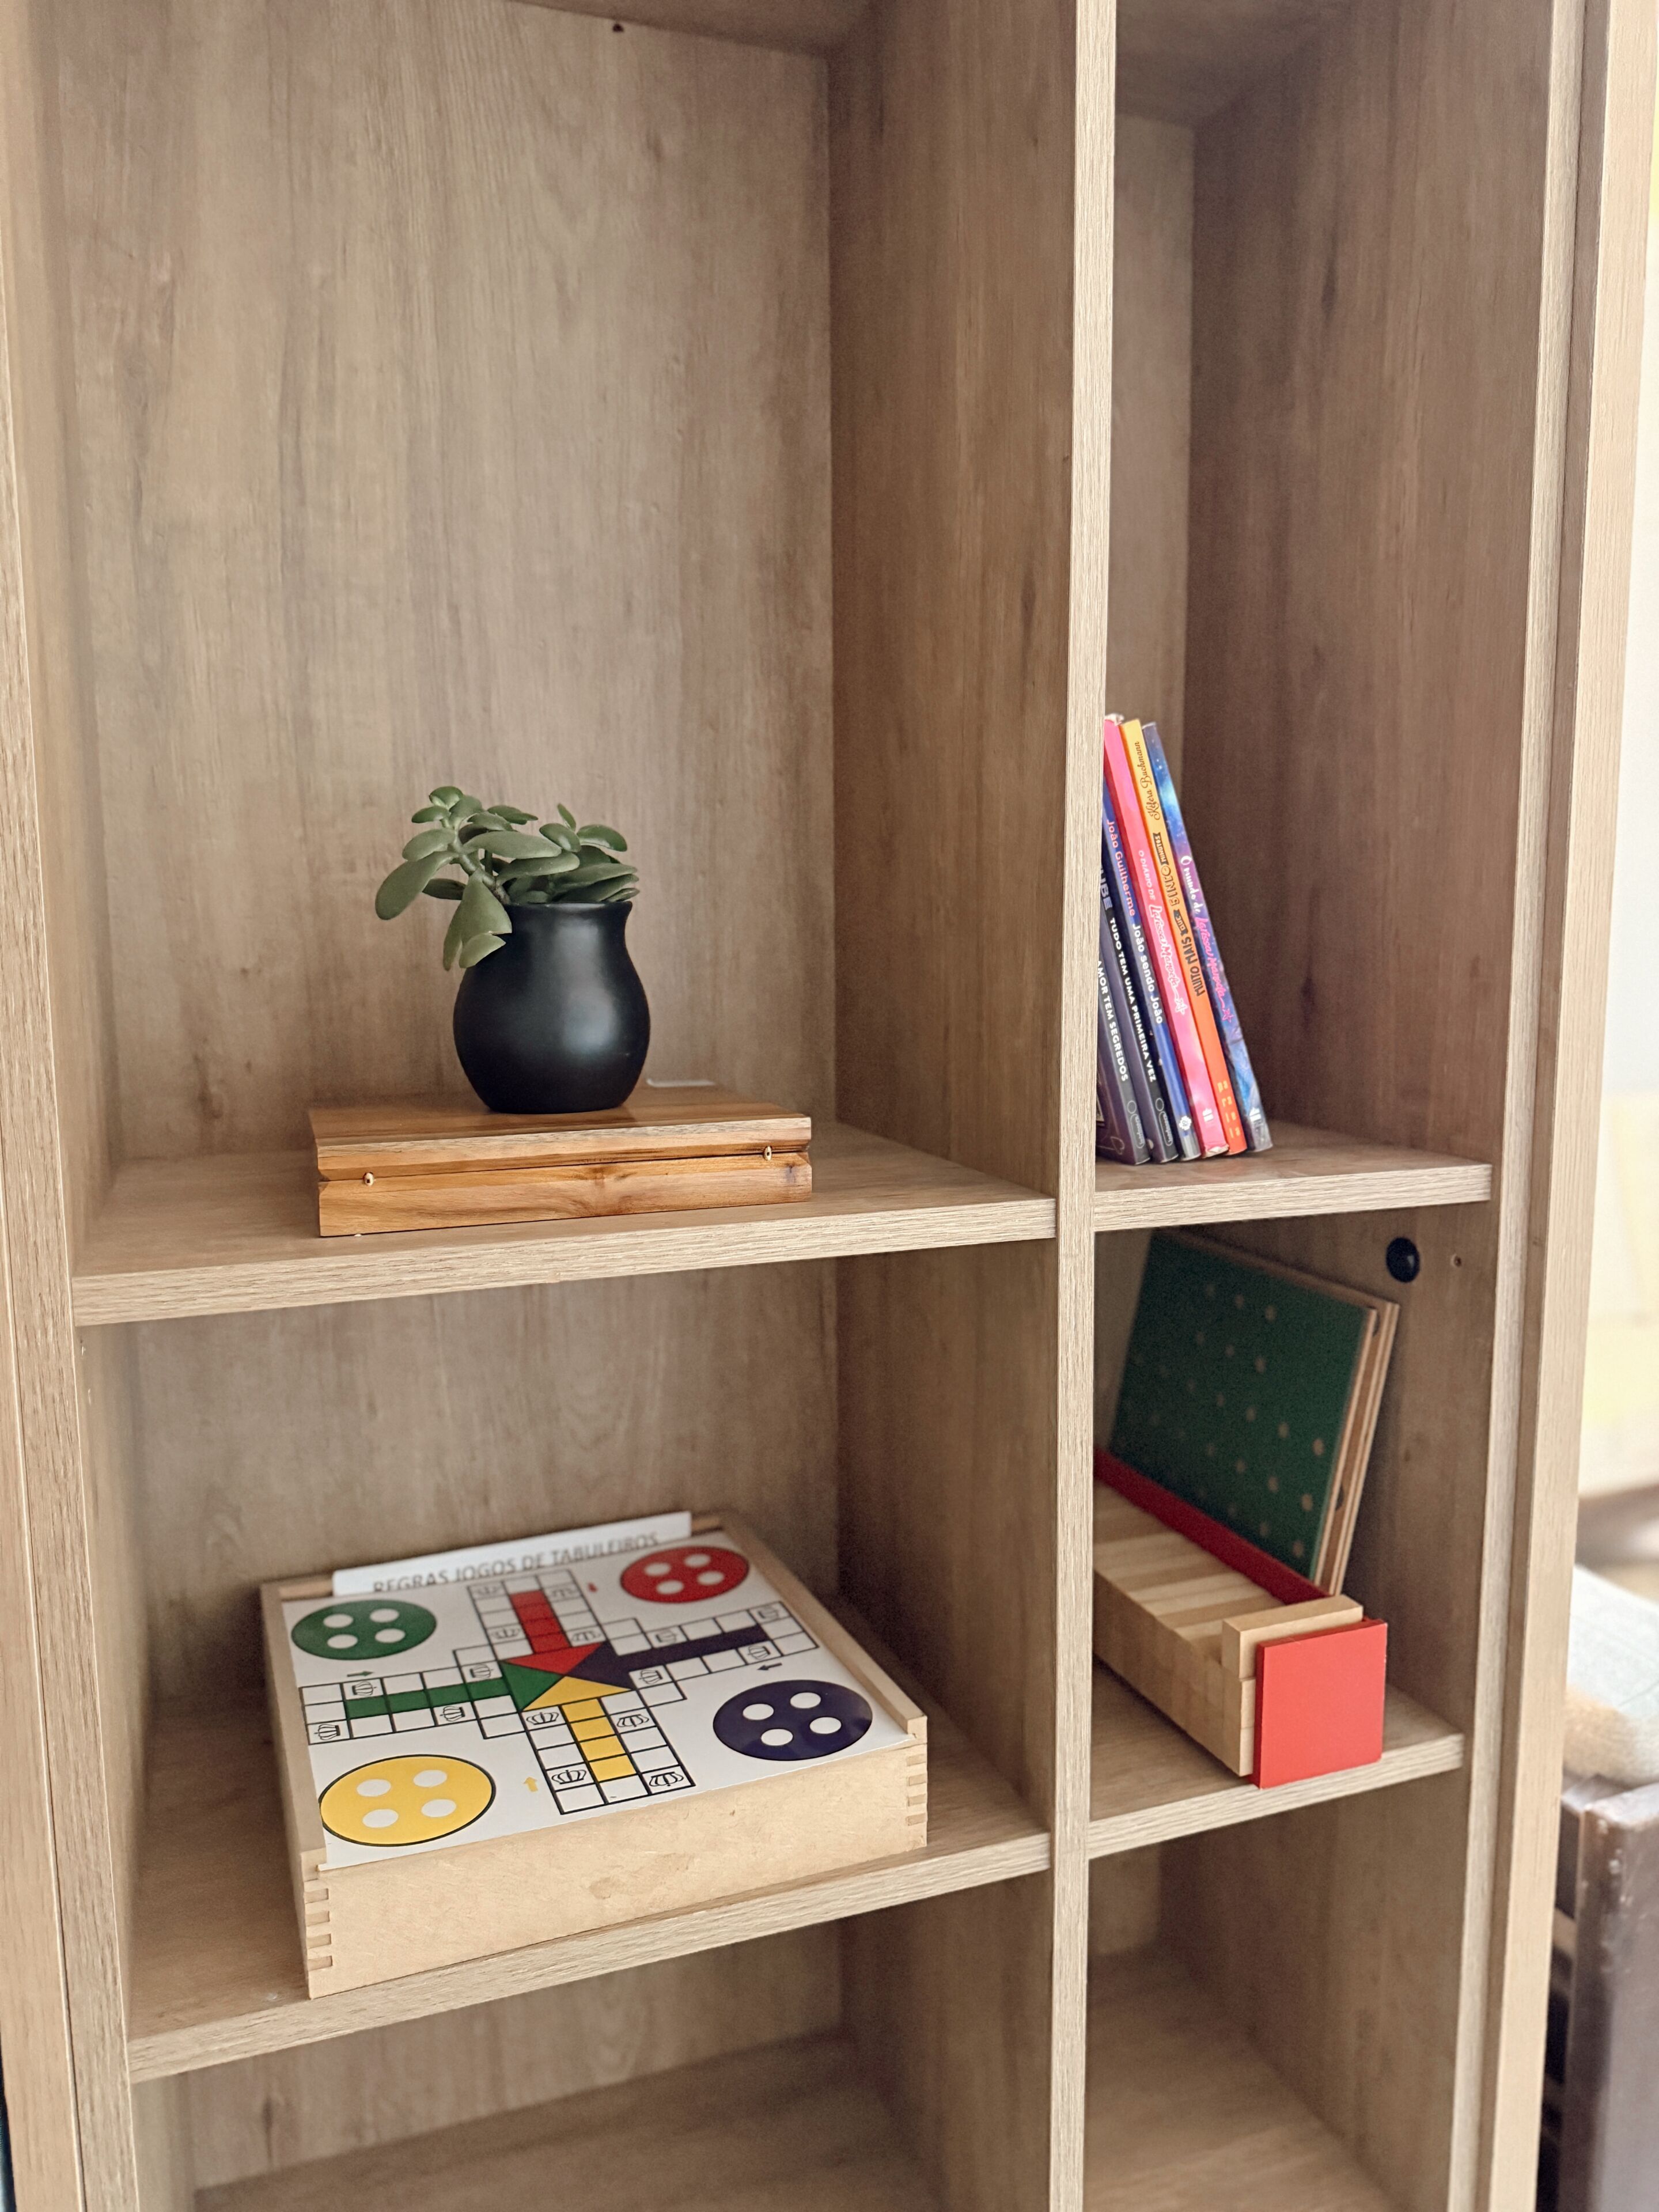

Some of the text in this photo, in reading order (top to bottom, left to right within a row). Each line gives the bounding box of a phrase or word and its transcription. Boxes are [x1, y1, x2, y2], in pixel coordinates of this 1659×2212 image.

[1134, 741, 1153, 789] Buchmann
[1155, 835, 1167, 863] MINUTOS
[1148, 889, 1156, 900] DE
[1106, 819, 1162, 1024] João Guilherme João sendo João
[1149, 905, 1168, 948] Larissa
[1181, 855, 1226, 999] O mundo de Larissa Manoela
[1161, 945, 1180, 988] Manoela
[1181, 936, 1198, 965] MAIS
[1110, 917, 1122, 950] TUDO
[1118, 951, 1128, 975] TEM
[1124, 977, 1135, 1004] UMA
[1131, 1005, 1149, 1060] PRIMEIRA
[1146, 1060, 1156, 1082] VEZ
[1190, 966, 1206, 997] MUITO
[1104, 995, 1114, 1020] TEM
[1109, 1021, 1128, 1081] SEGREDOS
[373, 1532, 659, 1592] REGRAS JOGOS DE TABULEIROS
